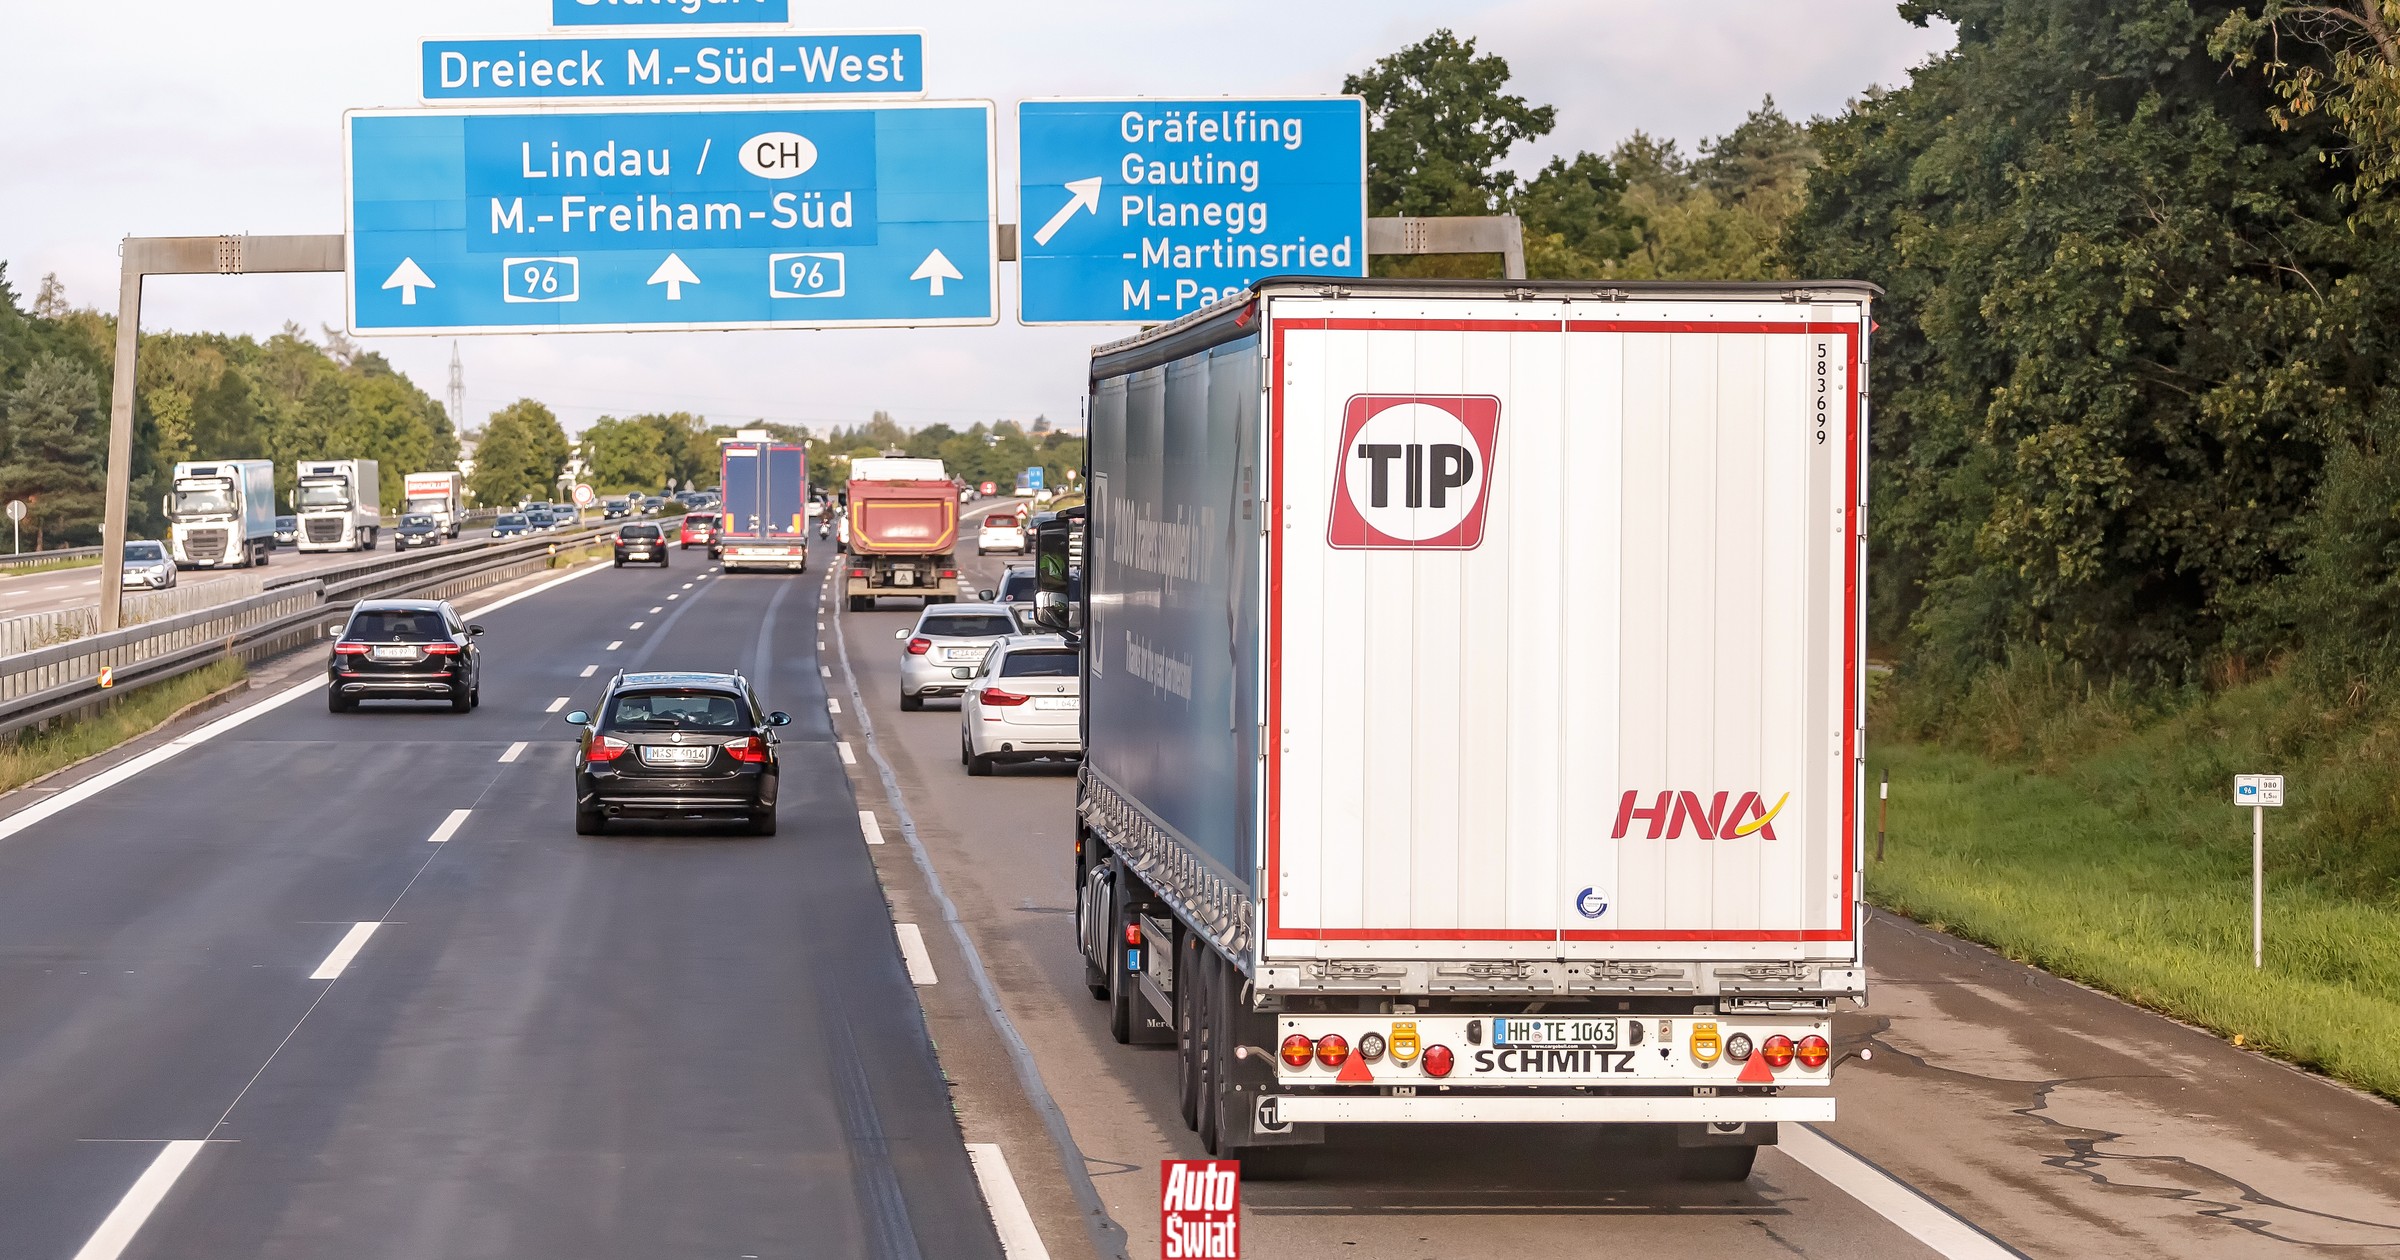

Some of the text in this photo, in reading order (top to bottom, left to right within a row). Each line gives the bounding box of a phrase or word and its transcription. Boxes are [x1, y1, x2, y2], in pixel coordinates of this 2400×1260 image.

[440, 46, 904, 88] Dreieck M.-Süd-West
[1121, 111, 1302, 150] Gräfelfing
[522, 138, 800, 178] Lindau / CH
[1121, 153, 1259, 192] Gauting
[491, 192, 853, 234] M.-Freiham-Süd
[1122, 196, 1267, 234] Planegg
[1122, 236, 1351, 268] -Martinsried
[524, 267, 557, 293] 96
[790, 263, 823, 289] 96
[1816, 343, 1827, 445] 583699
[1358, 444, 1474, 508] TIP
[1611, 790, 1789, 840] HNA
[1507, 1022, 1615, 1041] HH TE 1063
[1474, 1050, 1635, 1073] SCHMITZ
[1260, 1107, 1283, 1124] TI
